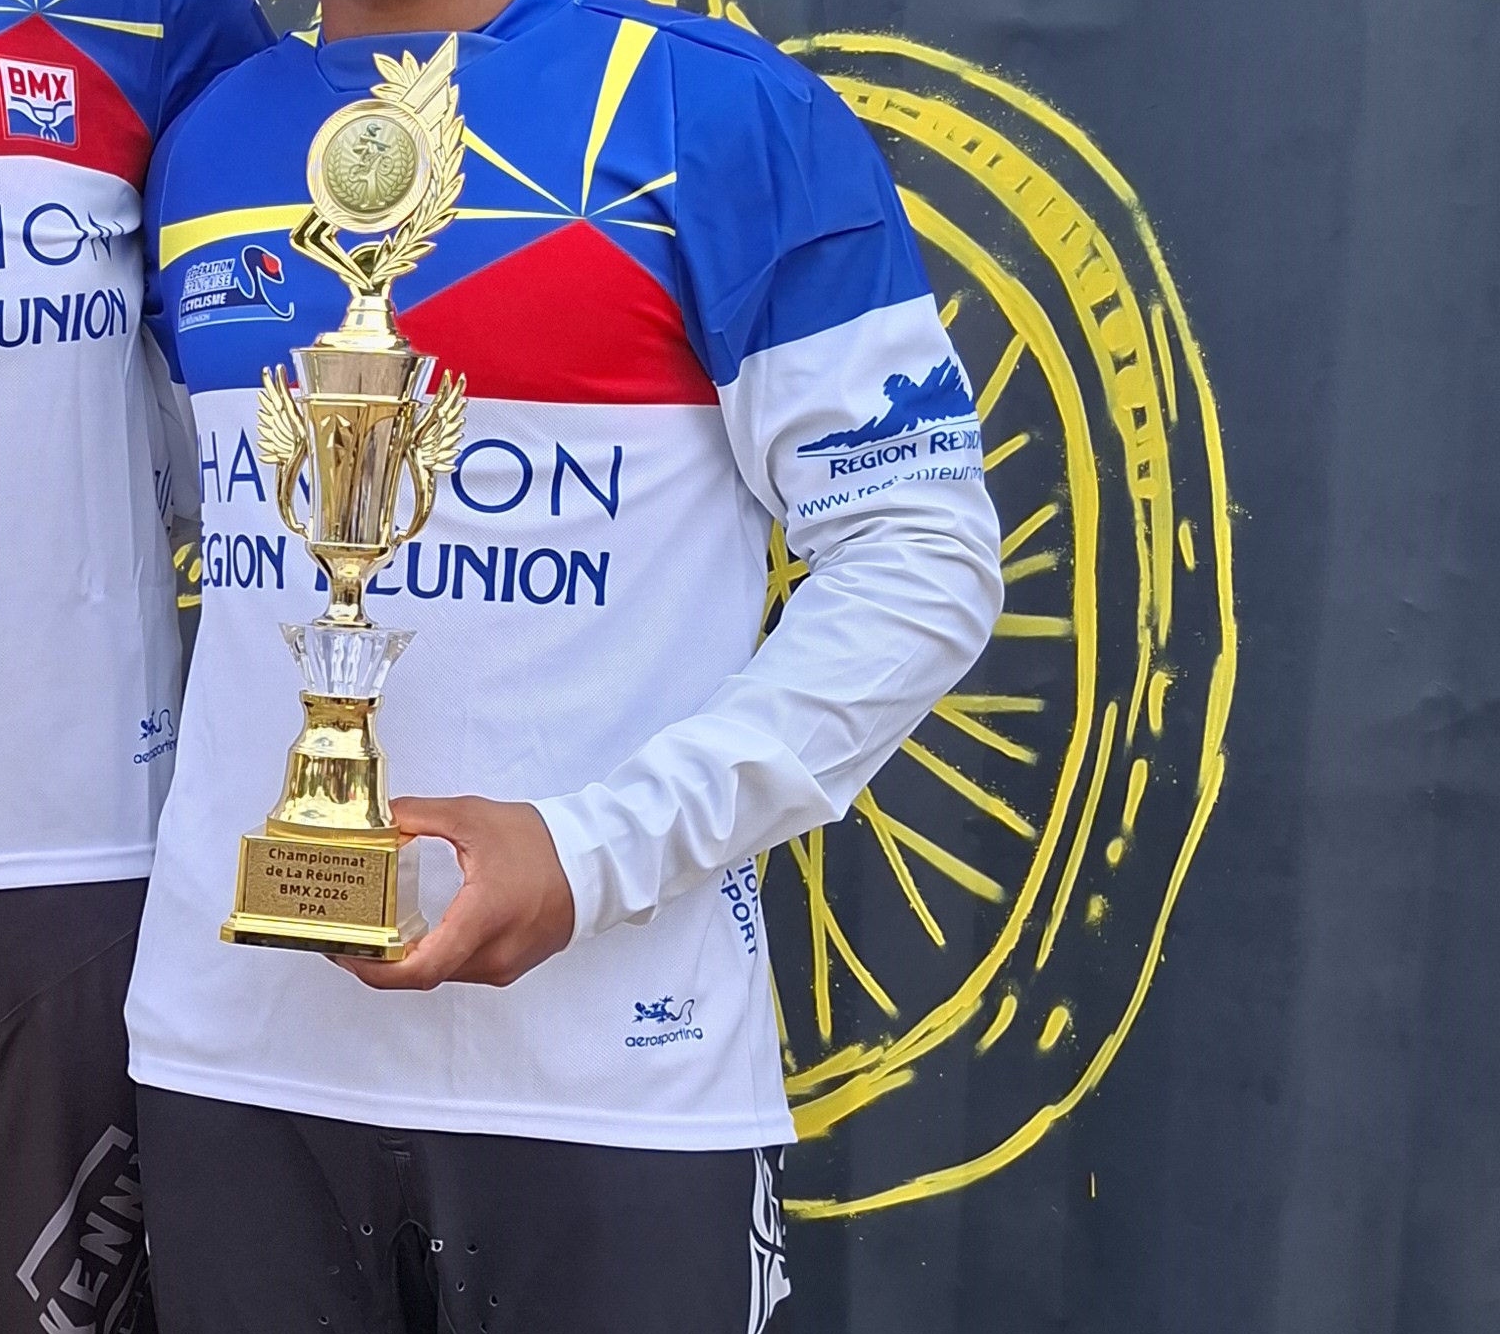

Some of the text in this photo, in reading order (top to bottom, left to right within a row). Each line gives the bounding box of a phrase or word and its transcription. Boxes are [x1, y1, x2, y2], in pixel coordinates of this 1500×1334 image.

[7, 66, 67, 102] BMX
[830, 442, 917, 479] REGION
[268, 847, 366, 868] Championnat
[265, 864, 365, 886] de La Réunion
[279, 883, 349, 901] BMX 2026
[299, 902, 327, 916] PPA
